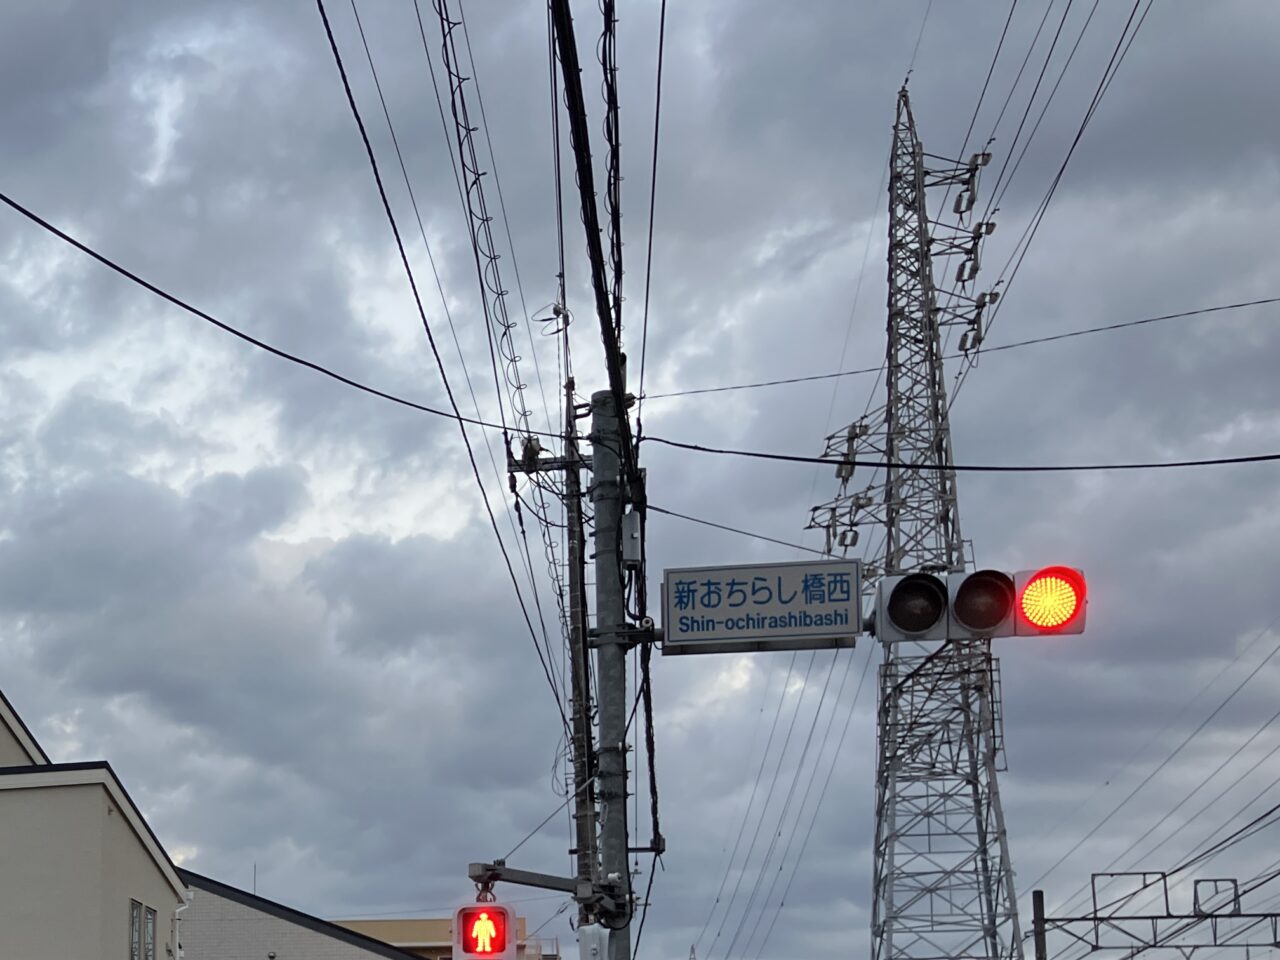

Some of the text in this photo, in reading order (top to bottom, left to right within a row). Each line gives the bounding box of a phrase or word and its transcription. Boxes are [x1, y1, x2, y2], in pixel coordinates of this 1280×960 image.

[673, 572, 852, 611] 新おちらし橋西
[678, 608, 849, 633] Shin-ochirashibashi
